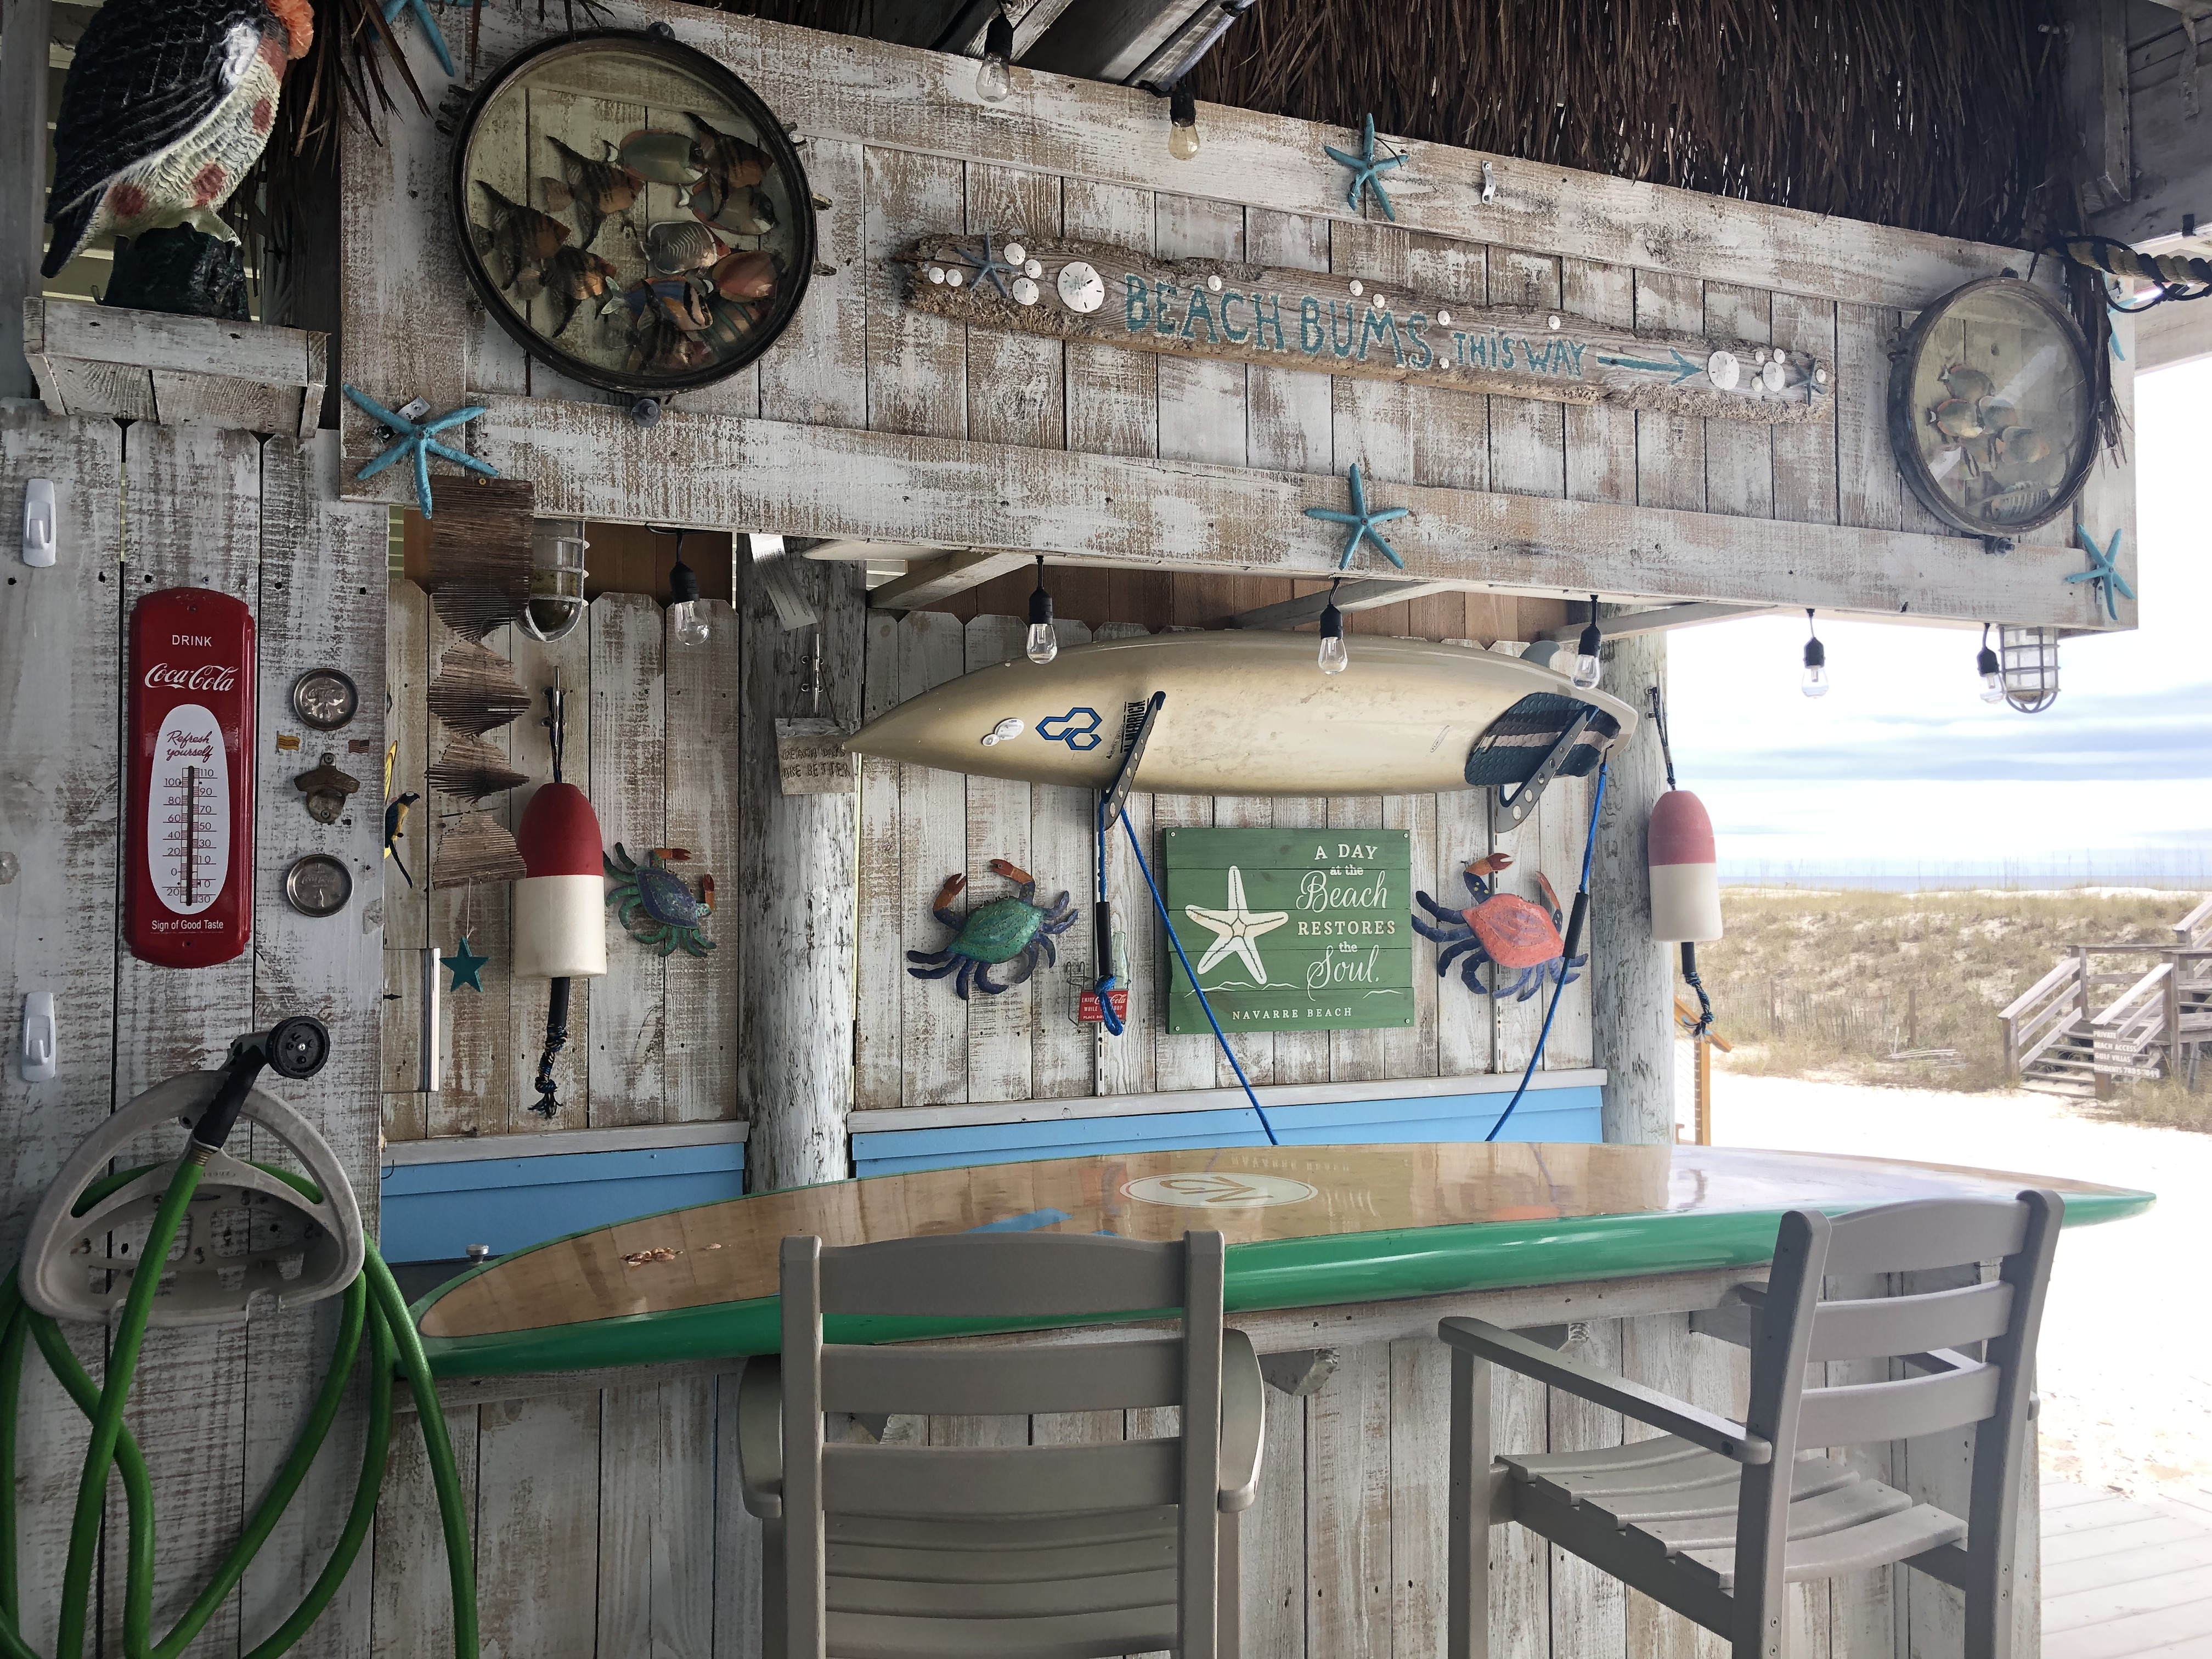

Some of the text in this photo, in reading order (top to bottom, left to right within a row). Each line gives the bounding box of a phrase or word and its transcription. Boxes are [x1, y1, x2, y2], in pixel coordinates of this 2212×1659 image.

[1125, 272, 1286, 353] BEACH
[1300, 295, 1434, 371] BUMS
[1520, 336, 1589, 380] WAY
[172, 634, 212, 647] DRINK
[144, 663, 239, 691] Coca-Cola
[166, 730, 213, 749] Refresh
[166, 745, 213, 763] yourself
[782, 761, 850, 778] ARE BETTER
[1314, 844, 1378, 860] A DAY
[1329, 864, 1364, 876] at the
[1296, 870, 1387, 913] Beach
[151, 920, 224, 932] Sign of Good Taste
[1297, 920, 1395, 935] RESTORES
[1338, 940, 1358, 952] the
[1306, 944, 1380, 1001] Soul.
[1232, 1007, 1352, 1020] NAVARRE BEACH
[2093, 1030, 2117, 1039] PRIVATE
[2094, 1041, 2137, 1053] BEACH ACCESS
[2112, 1054, 2131, 1063] VILLAS
[2094, 1064, 2123, 1074] RESIDENTS
